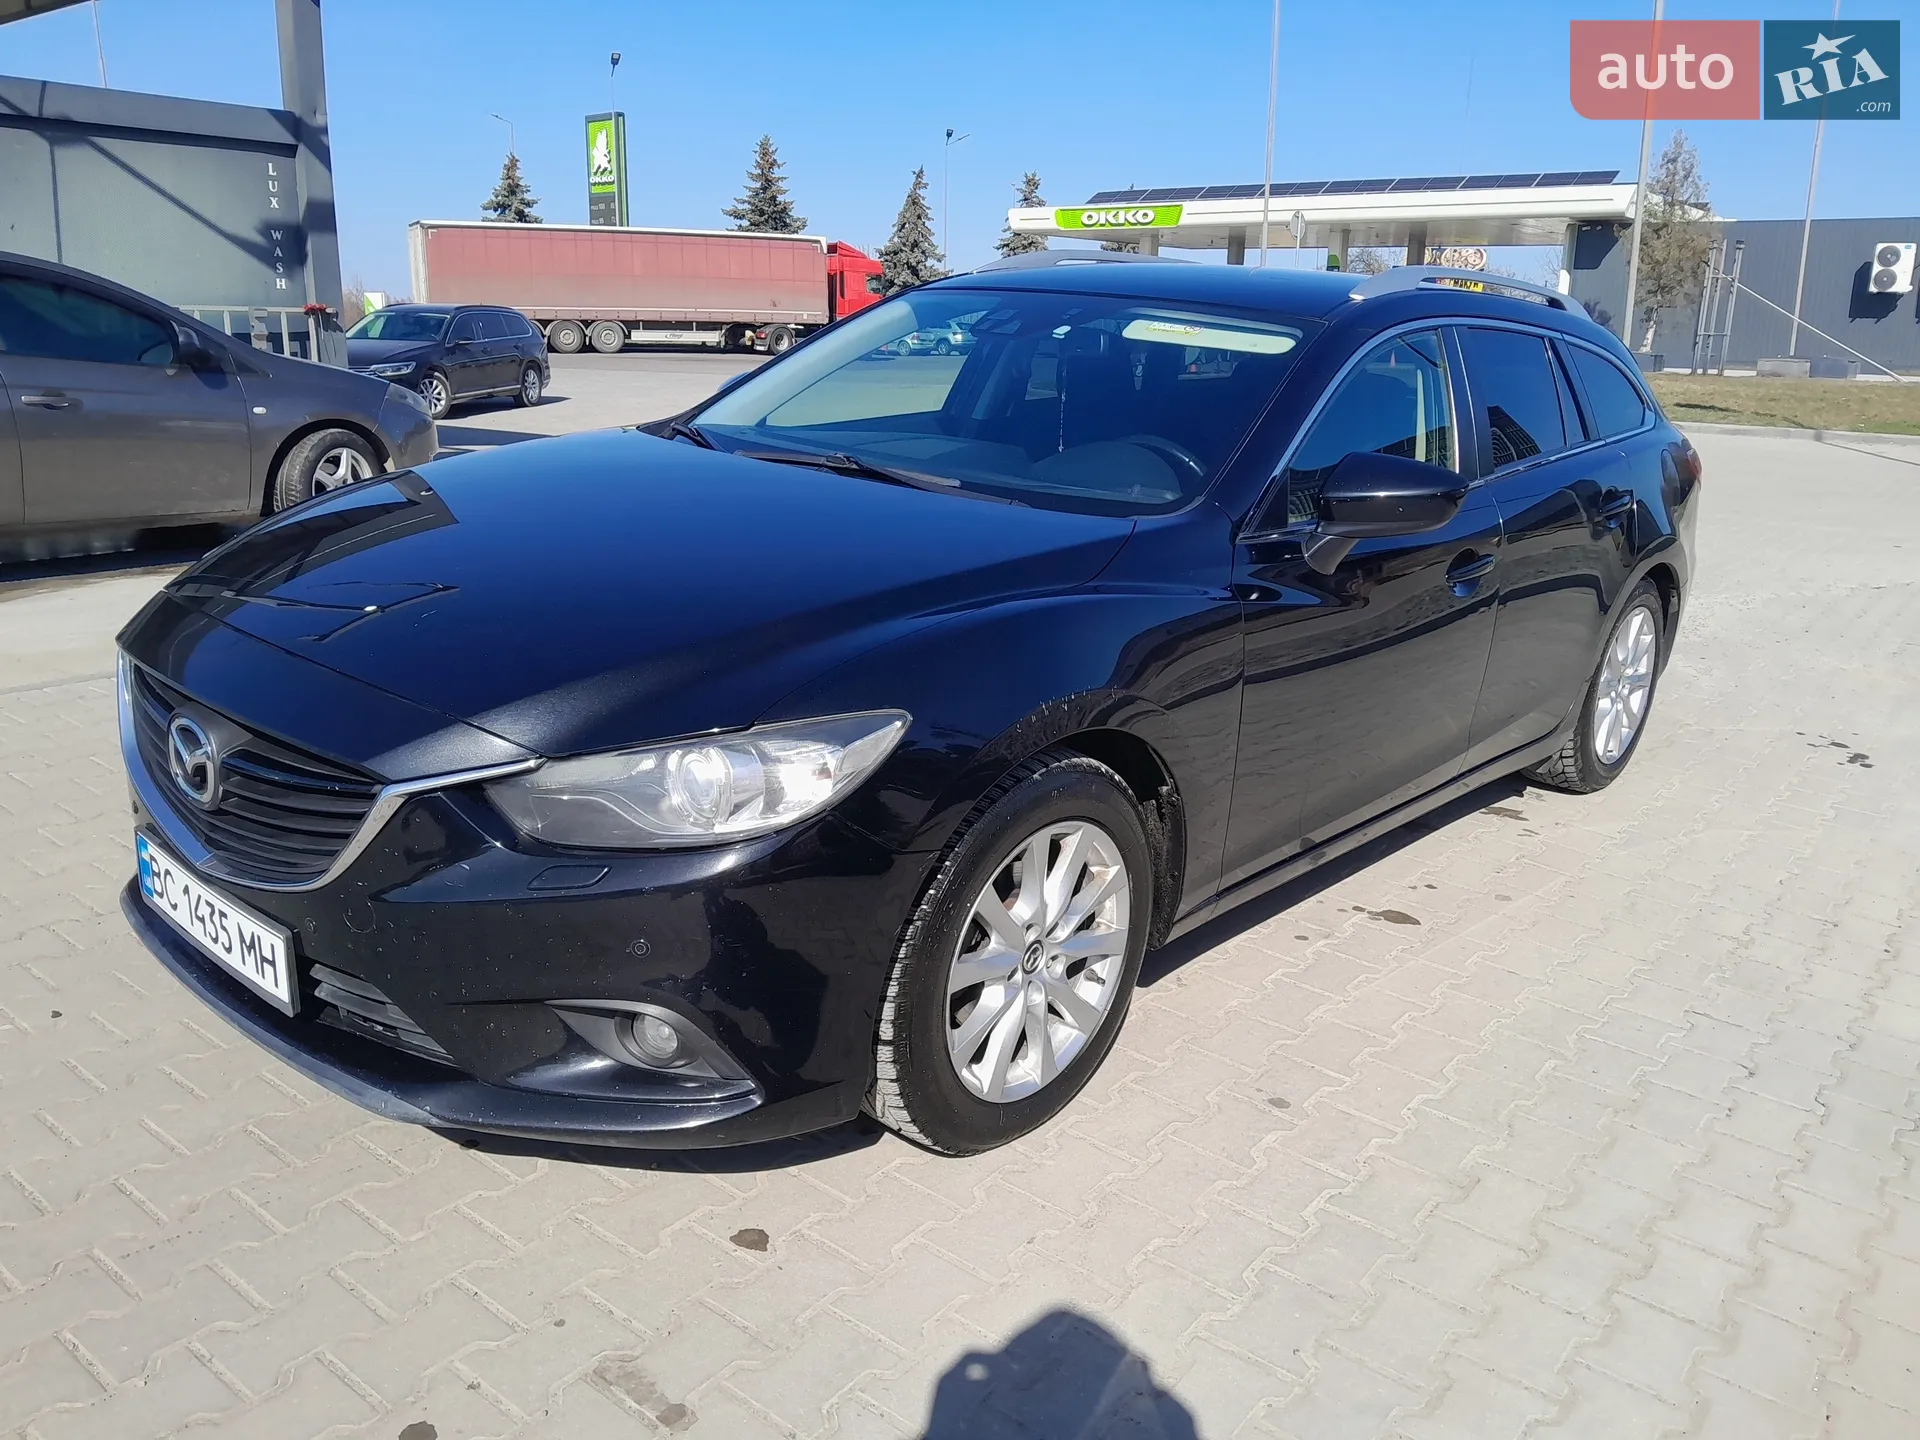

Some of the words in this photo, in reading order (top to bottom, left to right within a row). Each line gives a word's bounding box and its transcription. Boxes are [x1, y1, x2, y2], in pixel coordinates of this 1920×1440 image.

[267, 162, 280, 209] LUX
[589, 175, 615, 184] OKKO
[1081, 209, 1156, 227] OKKO
[270, 229, 287, 290] WASH
[150, 853, 178, 912] BC
[182, 883, 233, 955] 1435
[237, 921, 279, 990] MH
